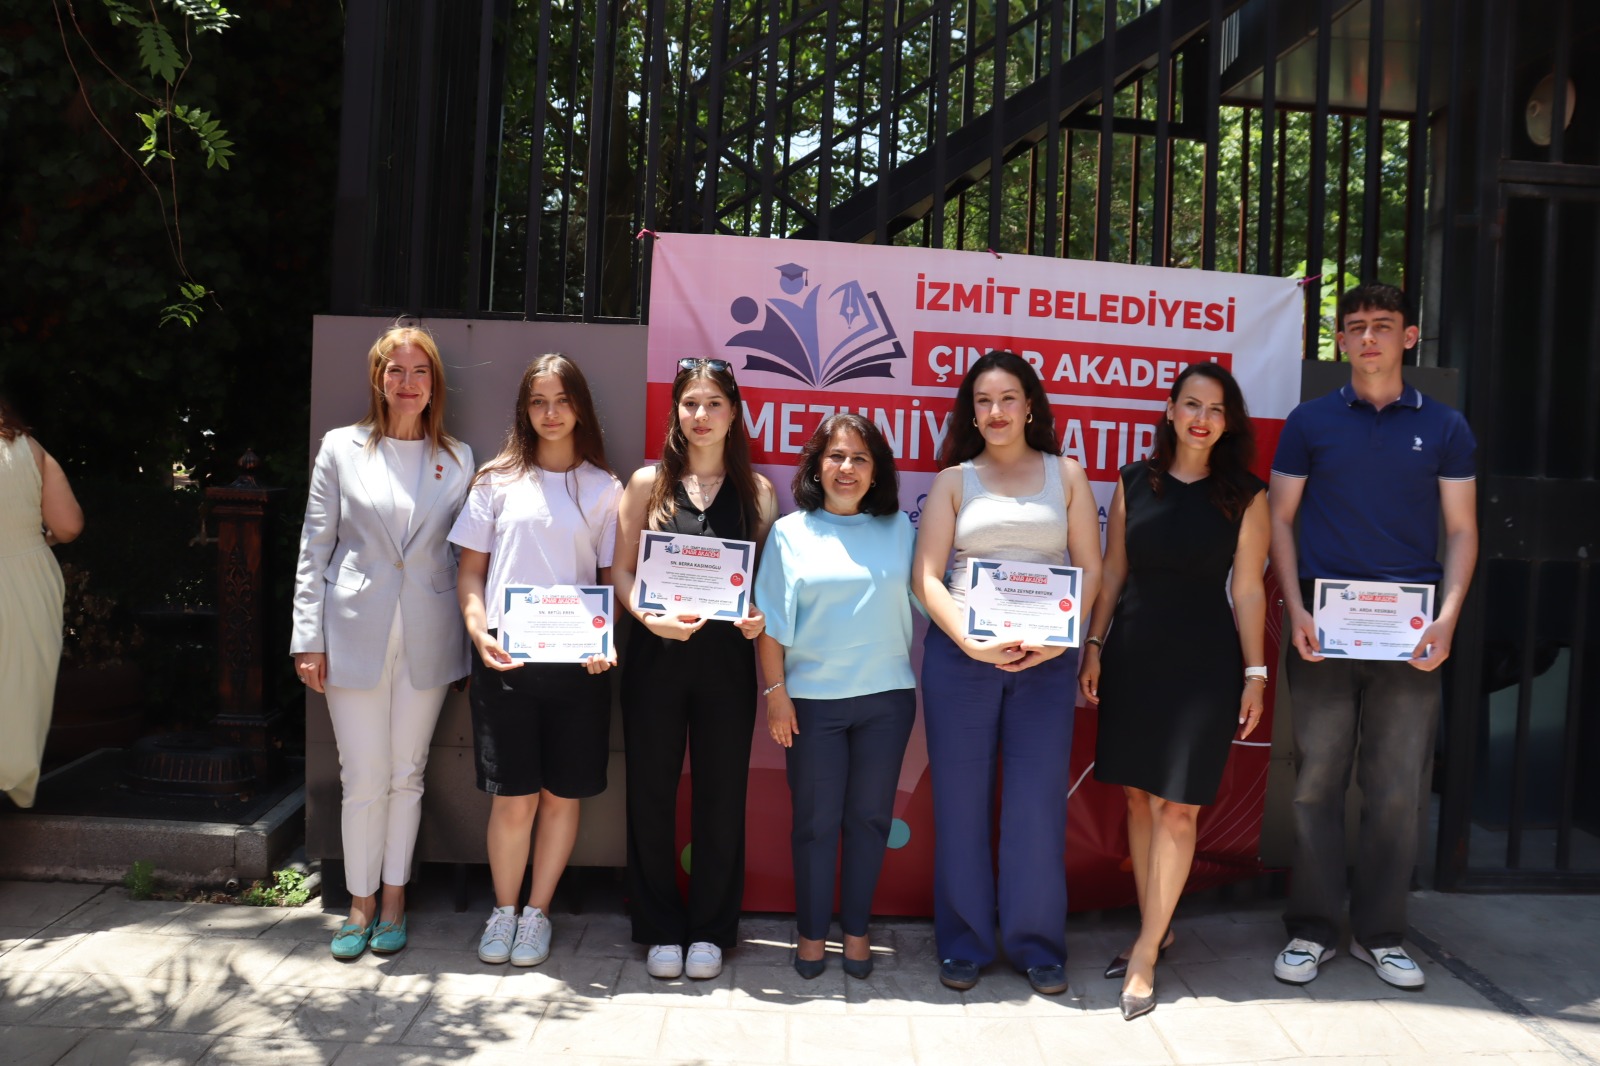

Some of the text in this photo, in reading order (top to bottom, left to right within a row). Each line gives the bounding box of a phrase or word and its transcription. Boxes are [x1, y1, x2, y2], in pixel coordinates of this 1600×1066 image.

[915, 273, 1236, 333] İZMİT BELEDİYESİ
[928, 345, 1218, 390] ÇINR AKADE
